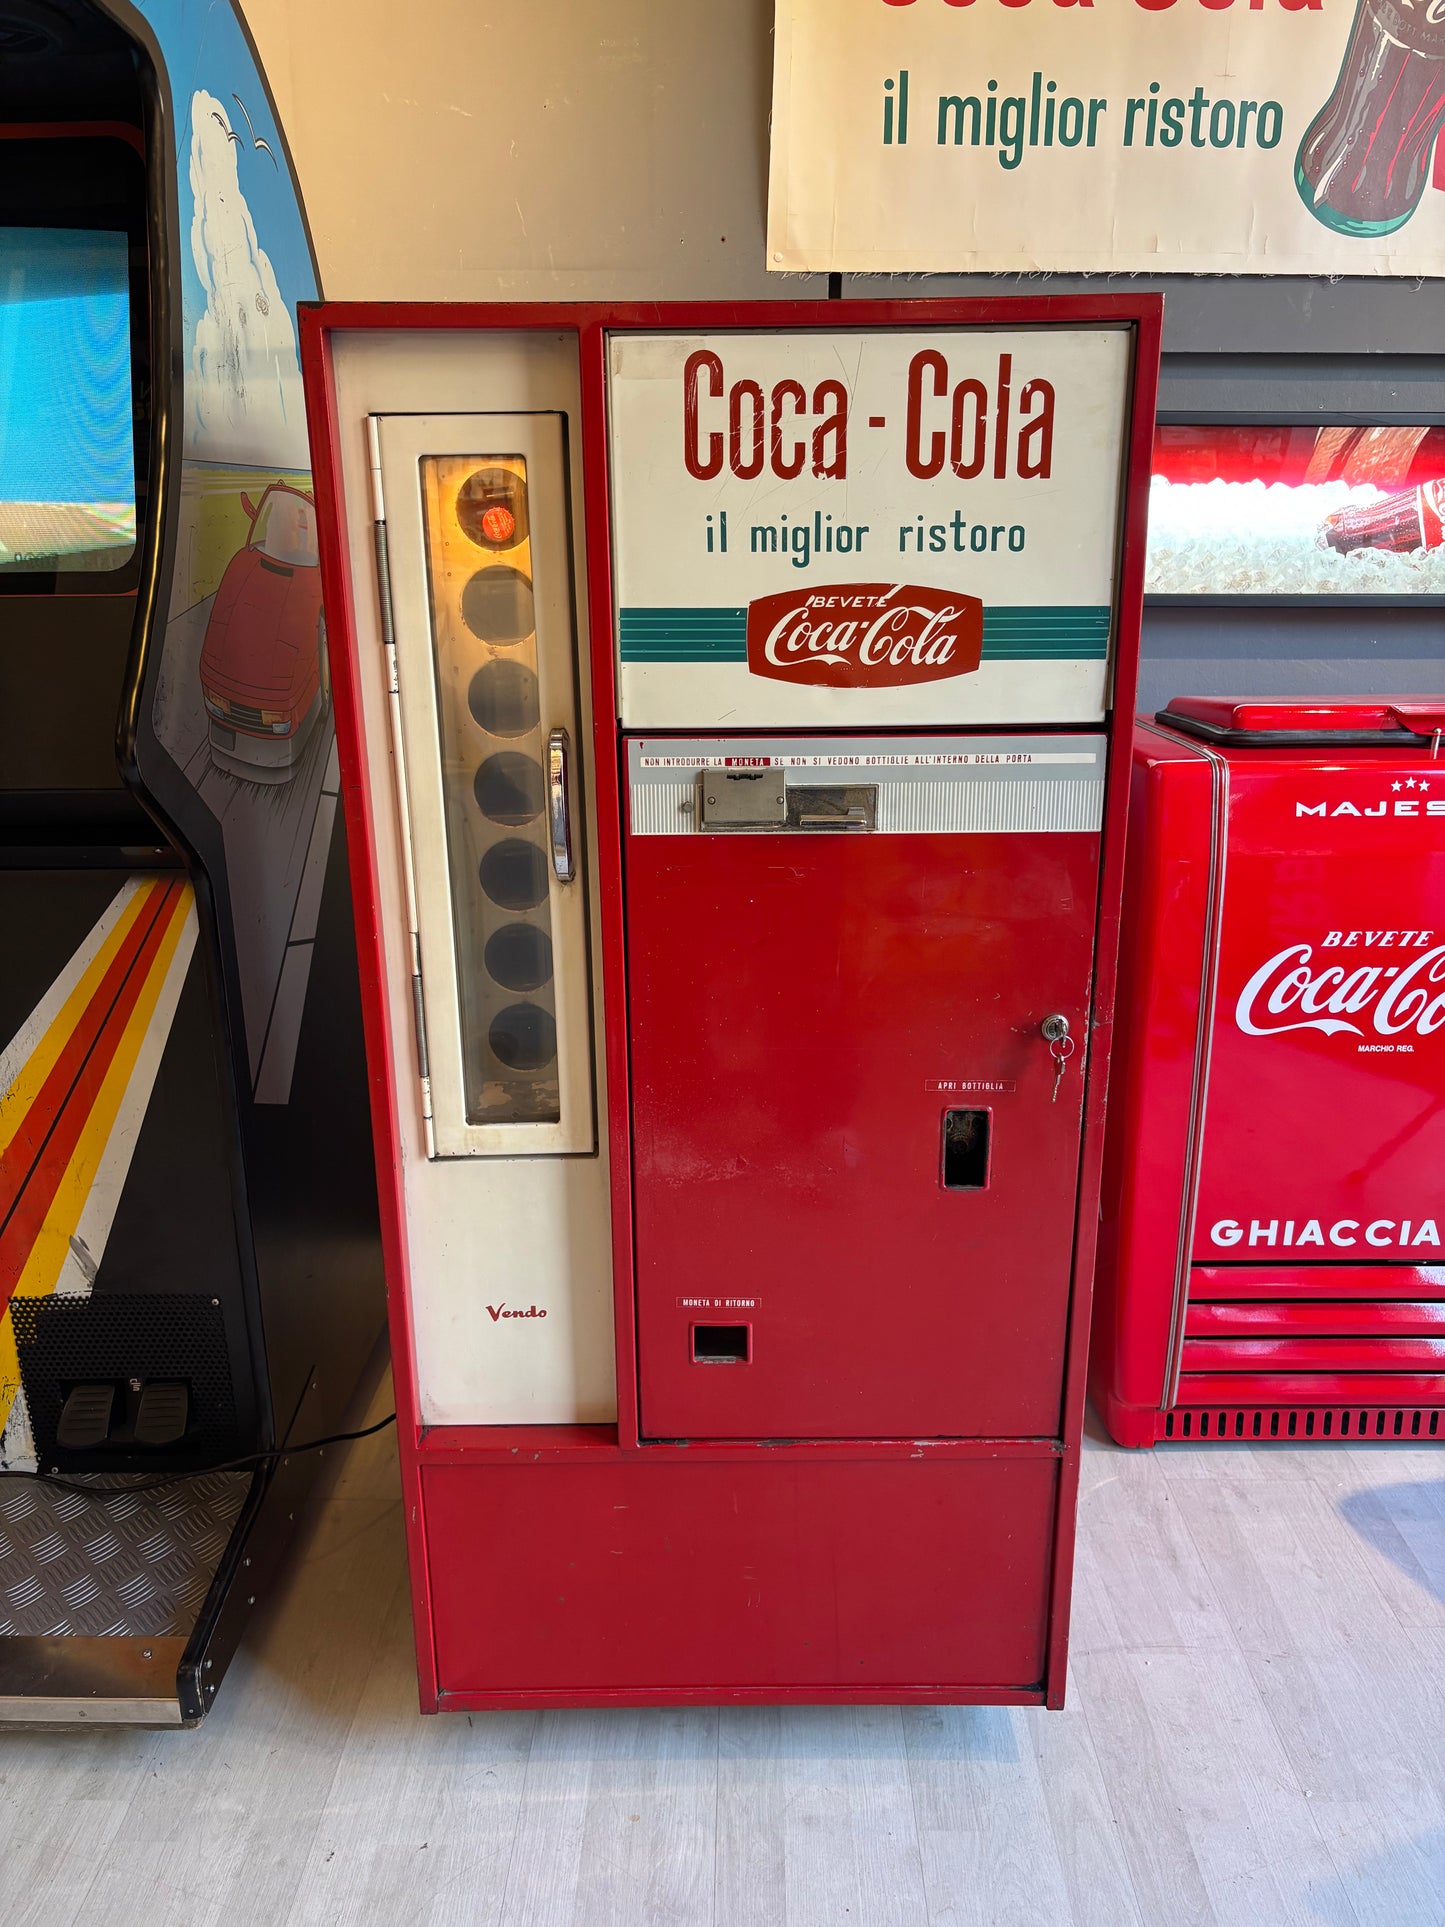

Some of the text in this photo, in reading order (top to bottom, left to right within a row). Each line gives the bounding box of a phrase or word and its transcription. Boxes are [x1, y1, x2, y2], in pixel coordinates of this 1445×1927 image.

[883, 70, 1284, 170] il miglior ristoro
[684, 349, 849, 481] Coca
[905, 349, 1056, 480] Cola
[706, 509, 1026, 569] il miglior ristoro
[810, 595, 889, 608] BEVETE
[764, 605, 967, 666] Coca-Cola
[644, 754, 1032, 766] NON INTRODURRE LA MONETA SE NON SI VEDONO BOTTIGLIE ALL'INTERNO DELLA PORTA
[1295, 800, 1445, 817] MAJES
[1321, 931, 1434, 947] BEVETE
[1358, 1045, 1415, 1053] MARCHIO REG.
[937, 1082, 1004, 1090] APRI BOTTIGLIA
[1210, 1219, 1441, 1247] GHIACCIA
[714, 1299, 722, 1307] DI
[725, 1299, 755, 1307] RITORNO
[485, 1302, 548, 1322] Vendo
